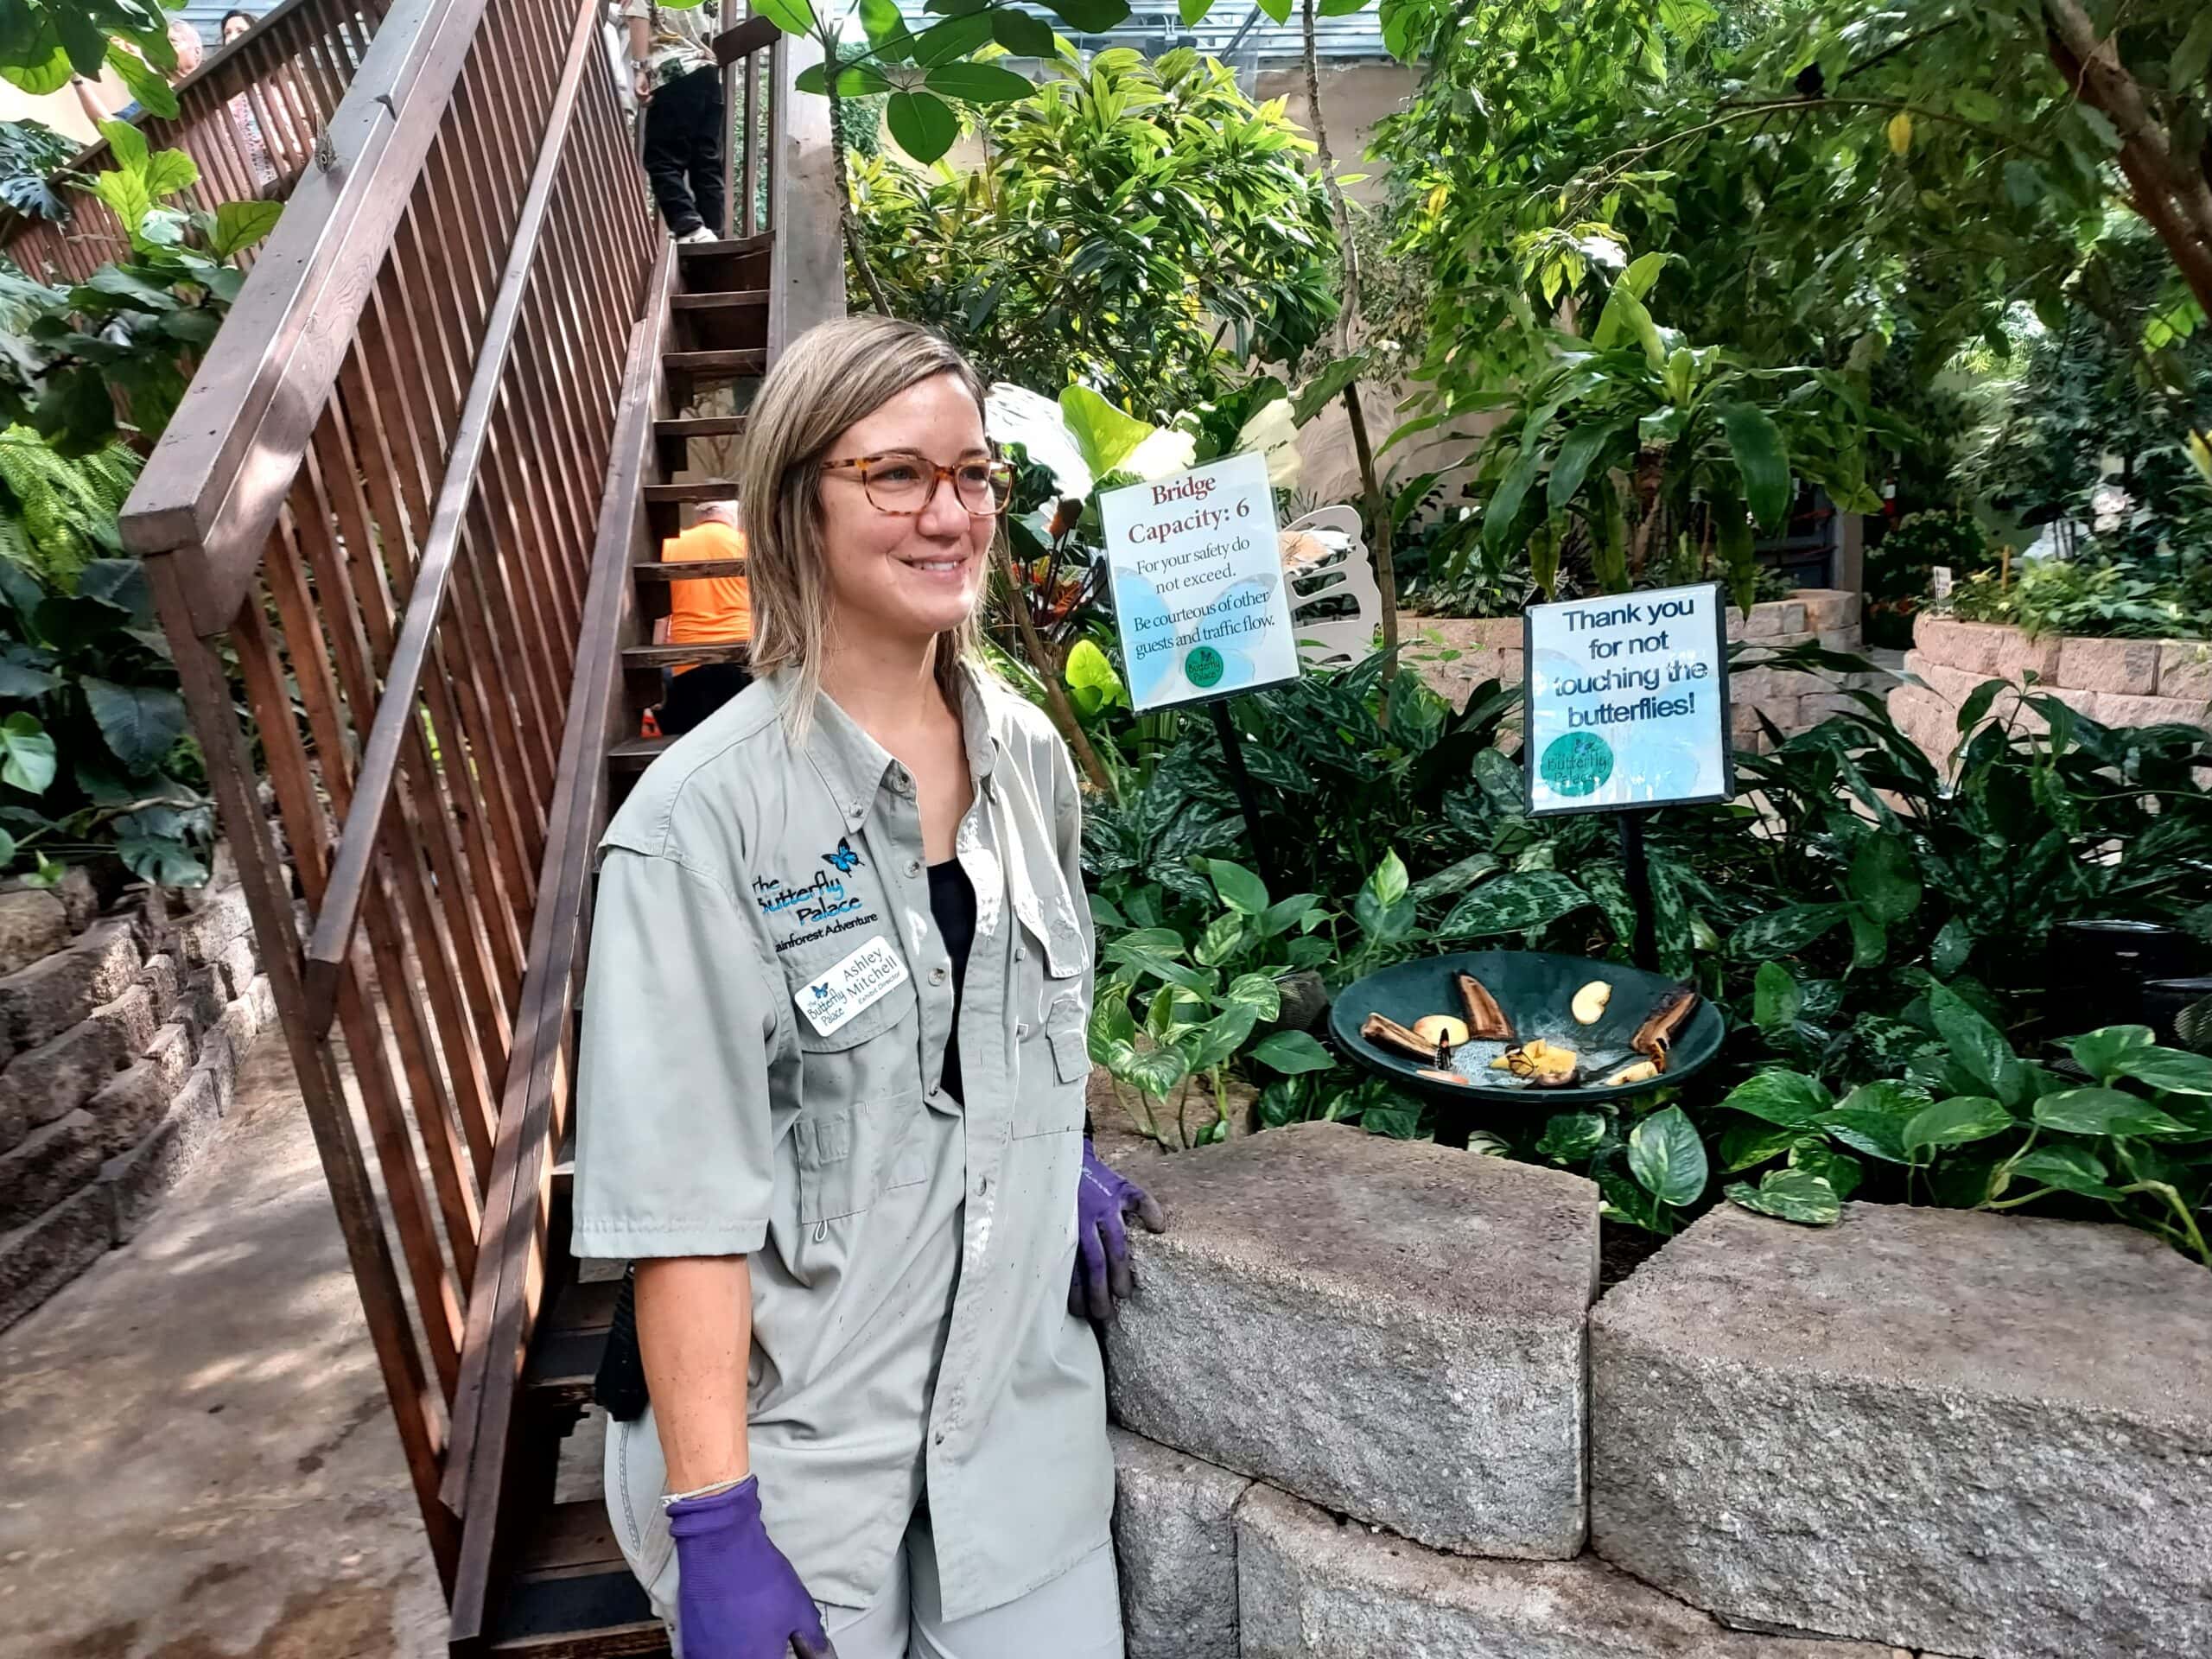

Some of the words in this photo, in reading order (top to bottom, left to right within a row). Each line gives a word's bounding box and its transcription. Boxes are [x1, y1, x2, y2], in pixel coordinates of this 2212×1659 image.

[1153, 476, 1217, 505] Bridge
[1128, 508, 1230, 543] Capacity:
[1236, 498, 1249, 518] 6
[1137, 560, 1160, 575] For
[1161, 553, 1192, 573] your
[1194, 542, 1230, 563] safety
[1231, 536, 1249, 551] do
[1156, 579, 1179, 594] not
[1183, 563, 1236, 588] exceed.
[1134, 616, 1152, 632] Be
[1154, 603, 1217, 627] courteous
[1218, 594, 1234, 612] of
[1234, 590, 1269, 608] other
[1562, 603, 1643, 632] Thank
[1647, 599, 1694, 626] you
[1135, 636, 1174, 660] guests
[1176, 627, 1200, 646] and
[1204, 620, 1242, 640] traffic
[1243, 614, 1275, 632] flow.
[1588, 638, 1623, 659] for
[1629, 630, 1669, 654] not
[1568, 692, 1695, 728] butterflies!
[797, 897, 862, 925] Palace
[775, 928, 824, 952] ainforest
[825, 912, 878, 937] Adventure
[843, 948, 882, 982] Ashley
[847, 955, 898, 998] Mitchell
[807, 988, 848, 1020] Butterfly
[821, 1007, 845, 1027] Palace
